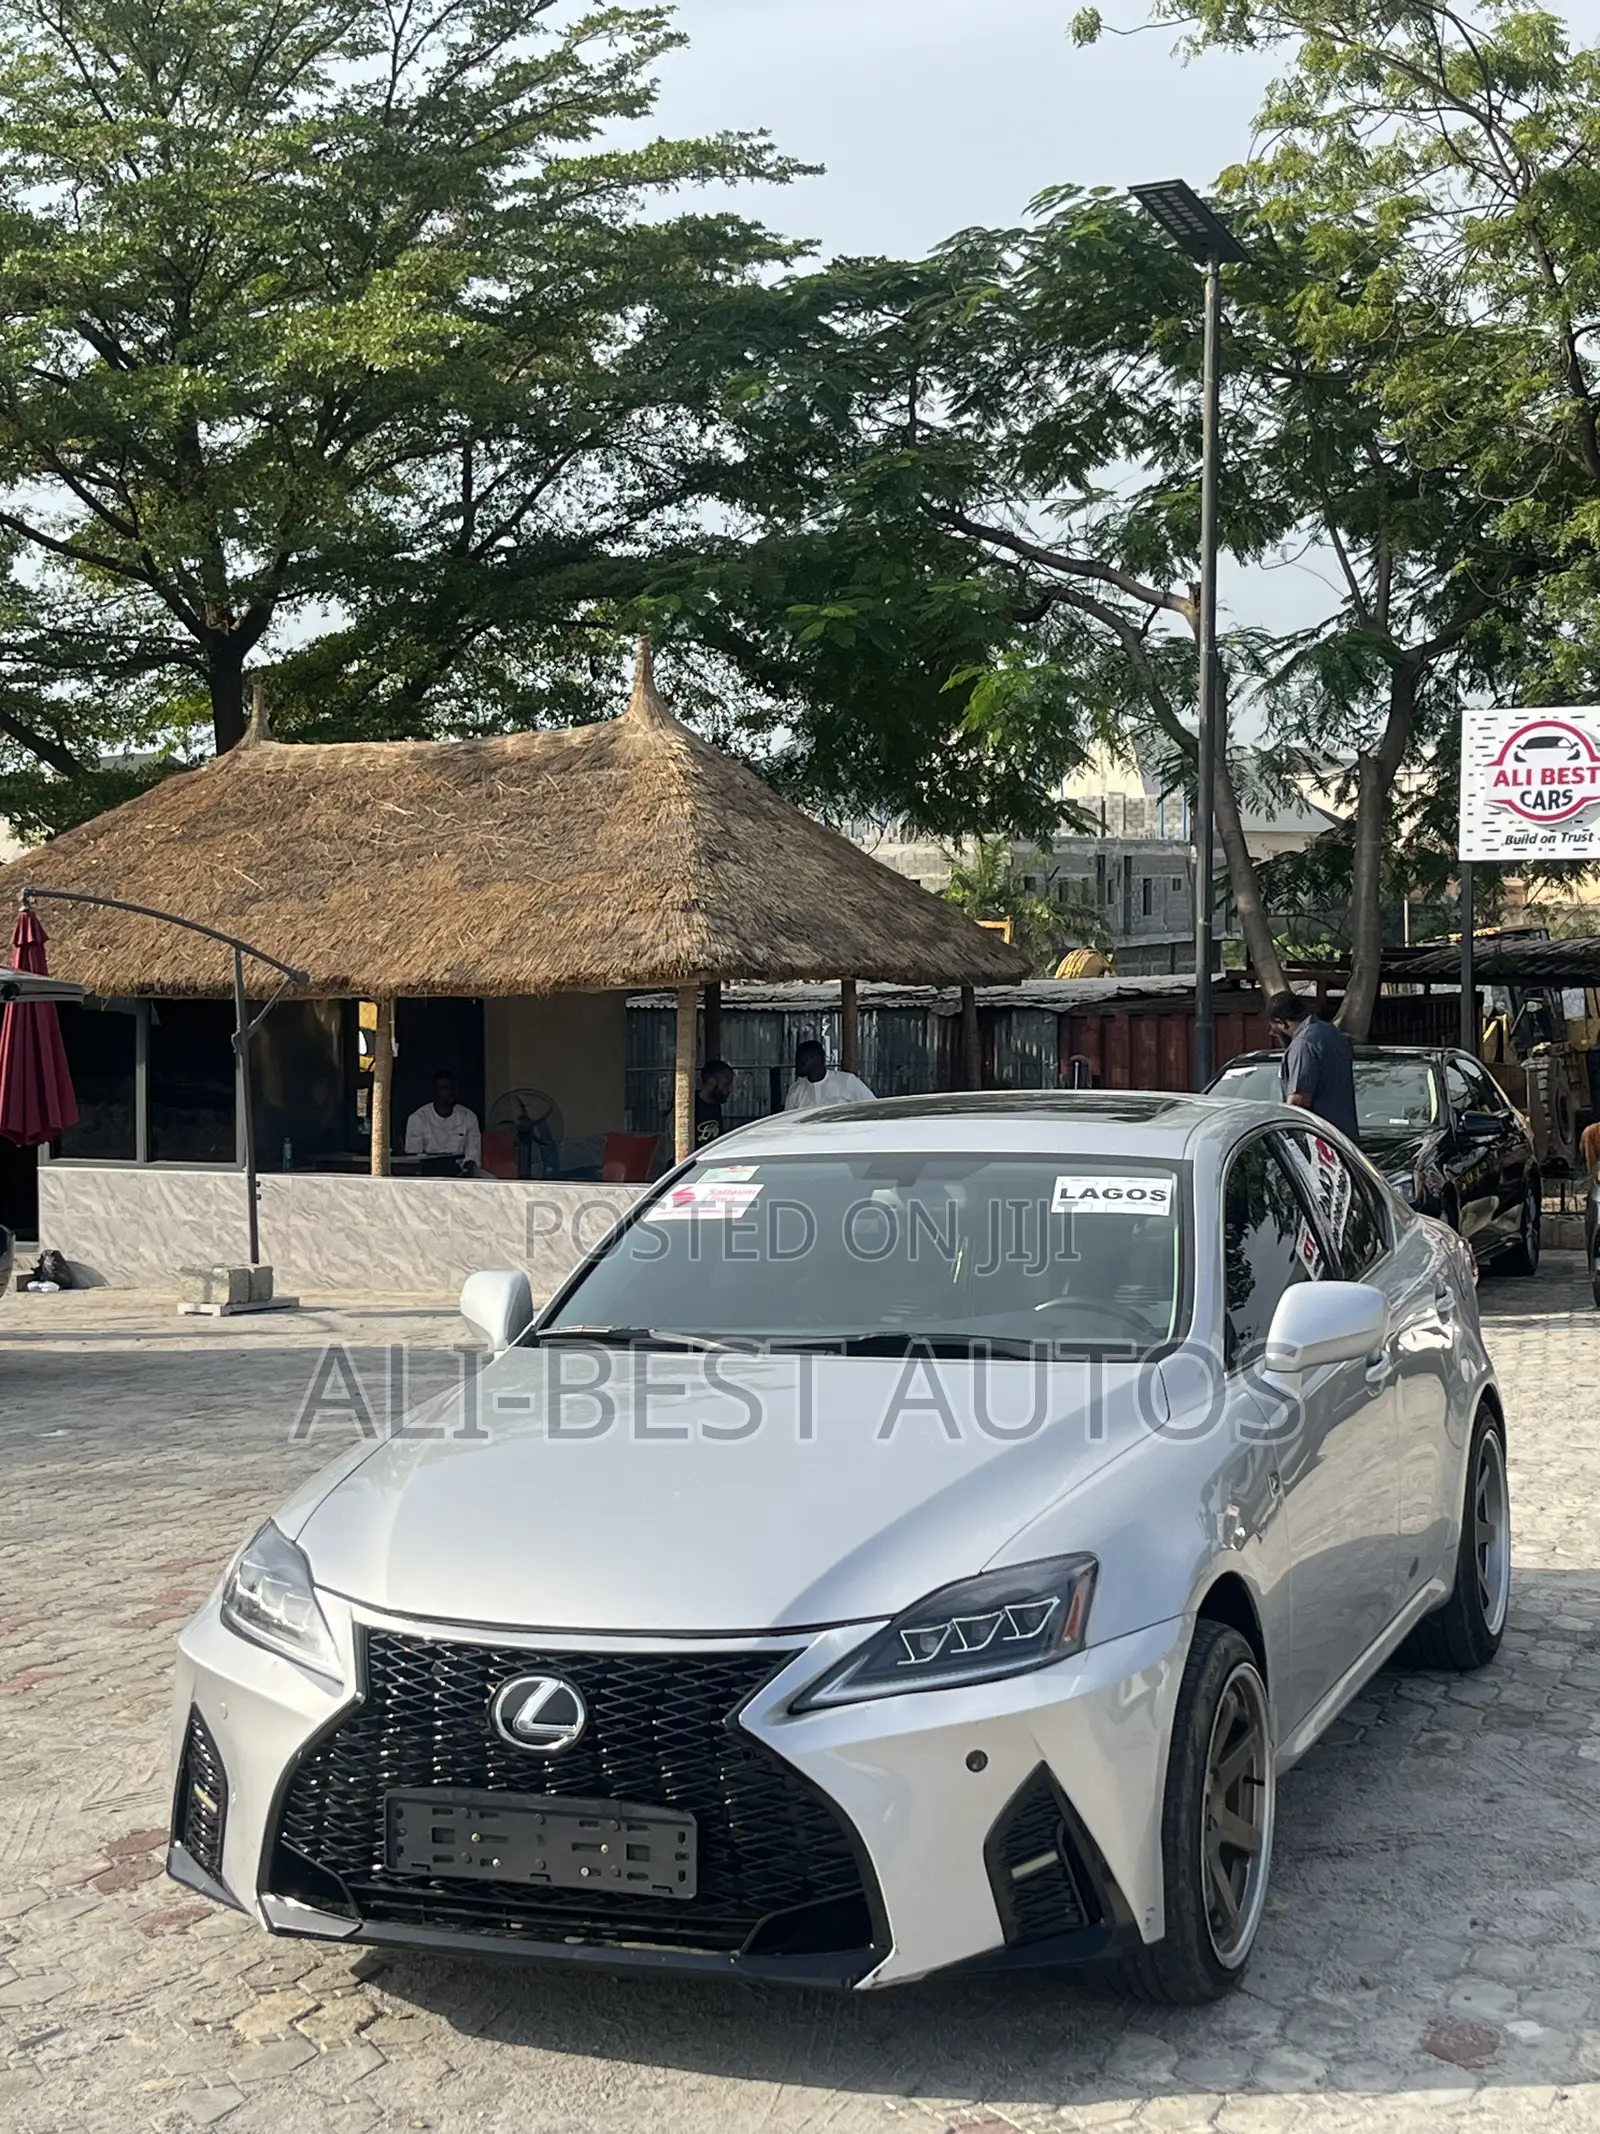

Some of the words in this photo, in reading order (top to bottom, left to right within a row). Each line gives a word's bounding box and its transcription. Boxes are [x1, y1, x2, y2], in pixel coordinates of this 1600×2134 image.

[1493, 768, 1532, 787] ALI
[1541, 767, 1600, 786] BEST
[1519, 788, 1573, 811] CARS
[1504, 832, 1539, 845] Build
[1540, 834, 1556, 844] on
[1560, 831, 1594, 844] Trust
[1059, 1187, 1167, 1202] LAGOS
